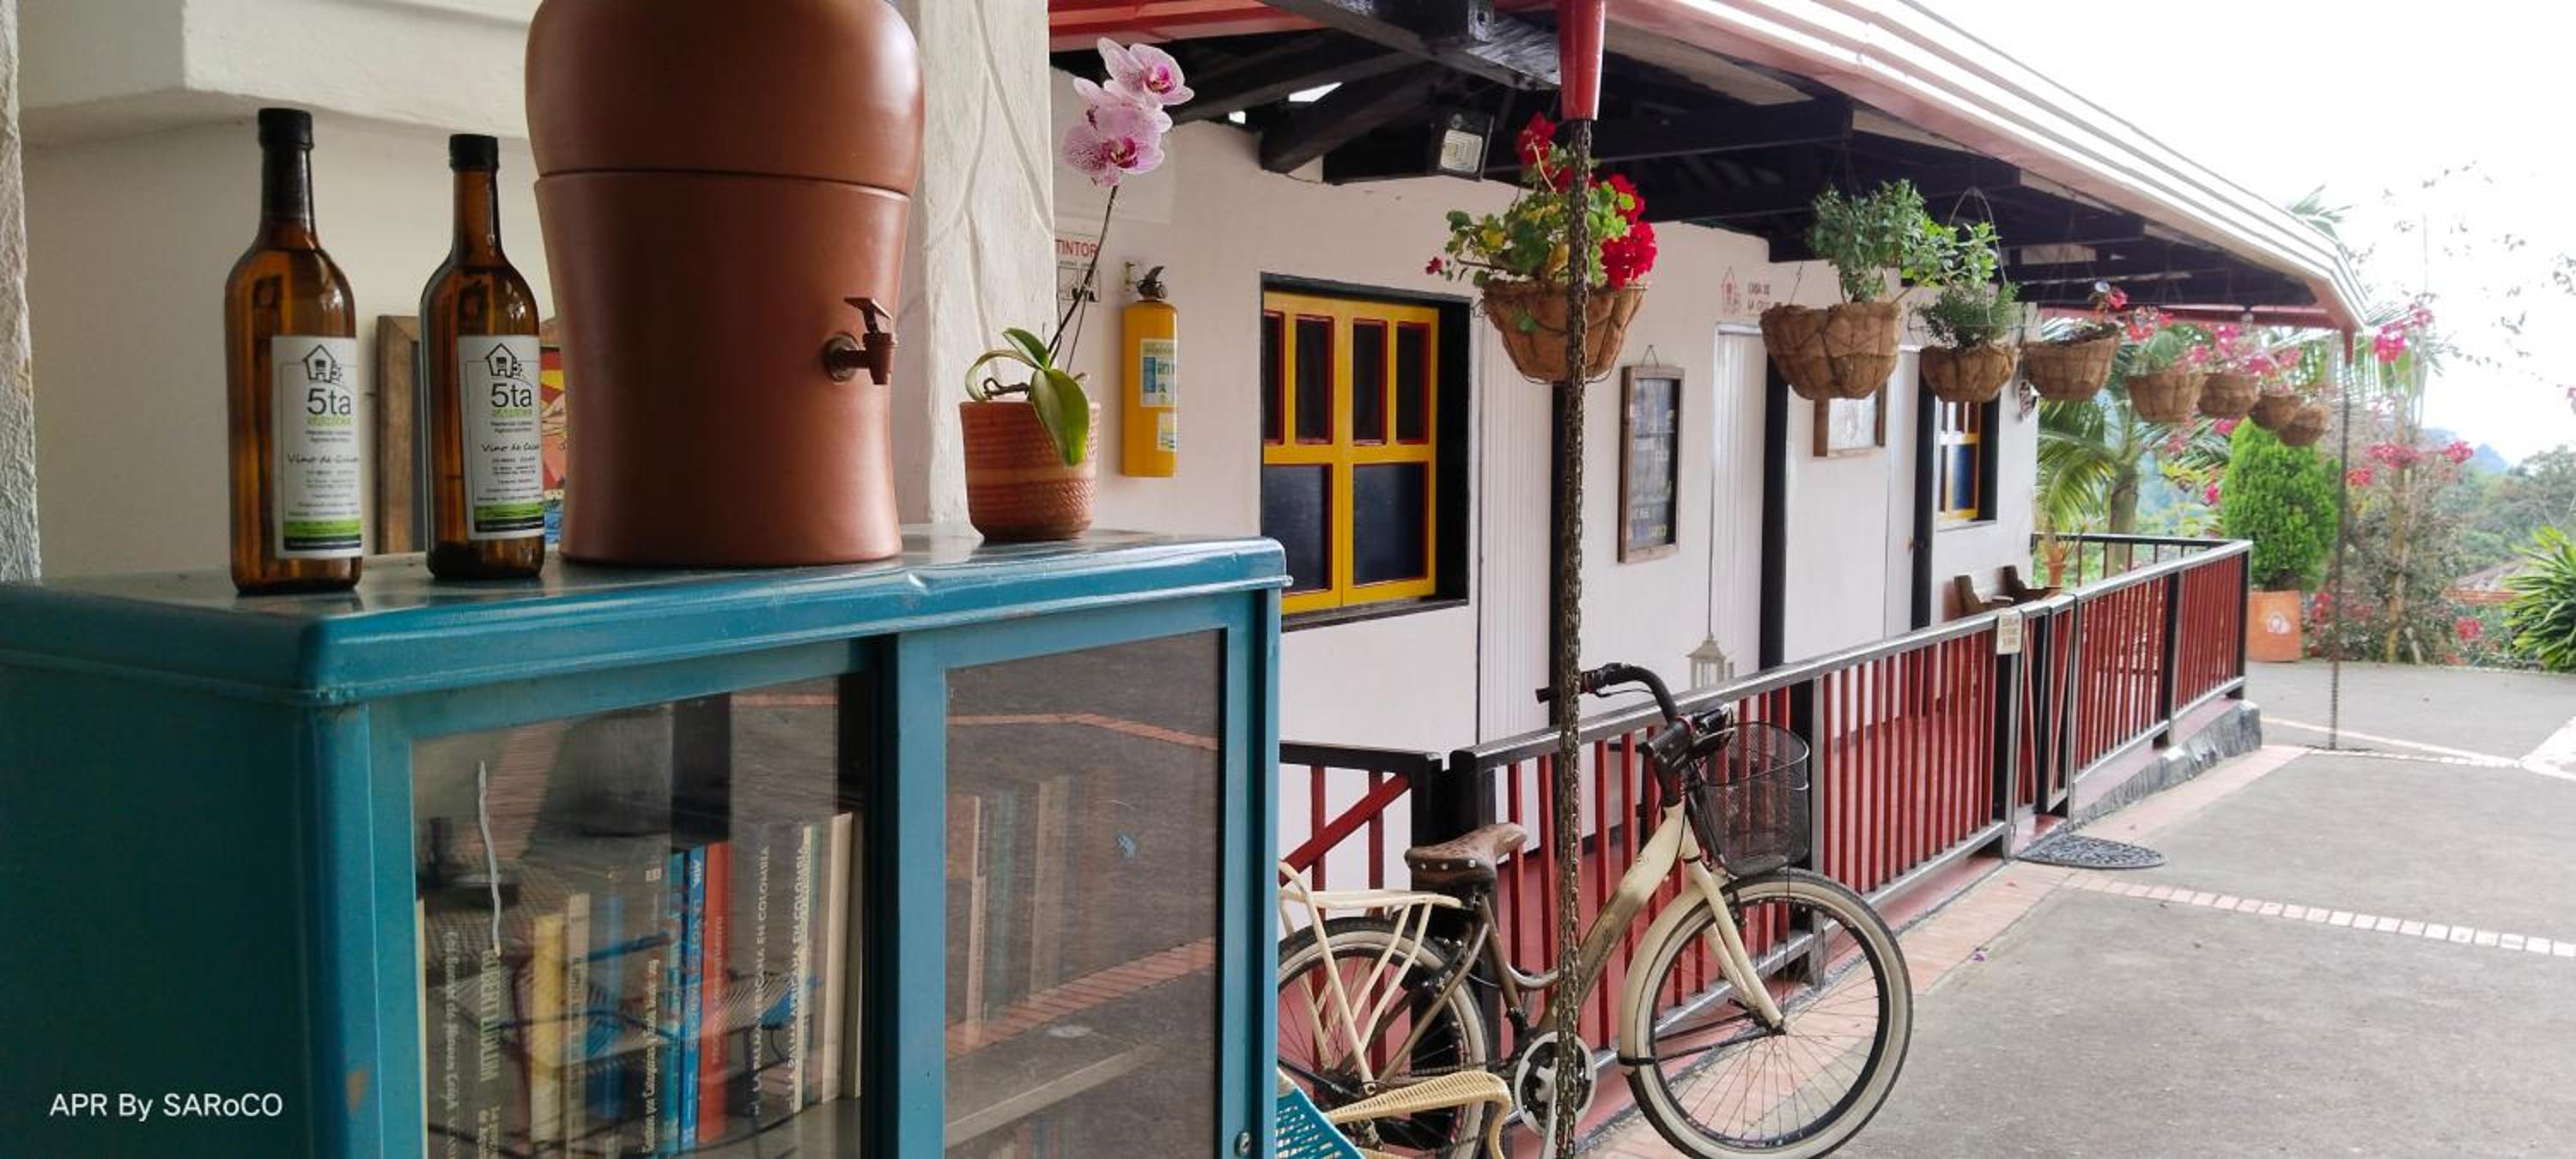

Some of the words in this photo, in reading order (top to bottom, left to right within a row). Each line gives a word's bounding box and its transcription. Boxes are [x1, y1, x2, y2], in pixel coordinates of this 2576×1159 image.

[1054, 239, 1097, 258] TINTOR
[307, 387, 351, 416] 5ta
[491, 383, 532, 408] 5ta
[757, 844, 769, 922] COLOMBIA
[480, 949, 501, 1013] ROBERT
